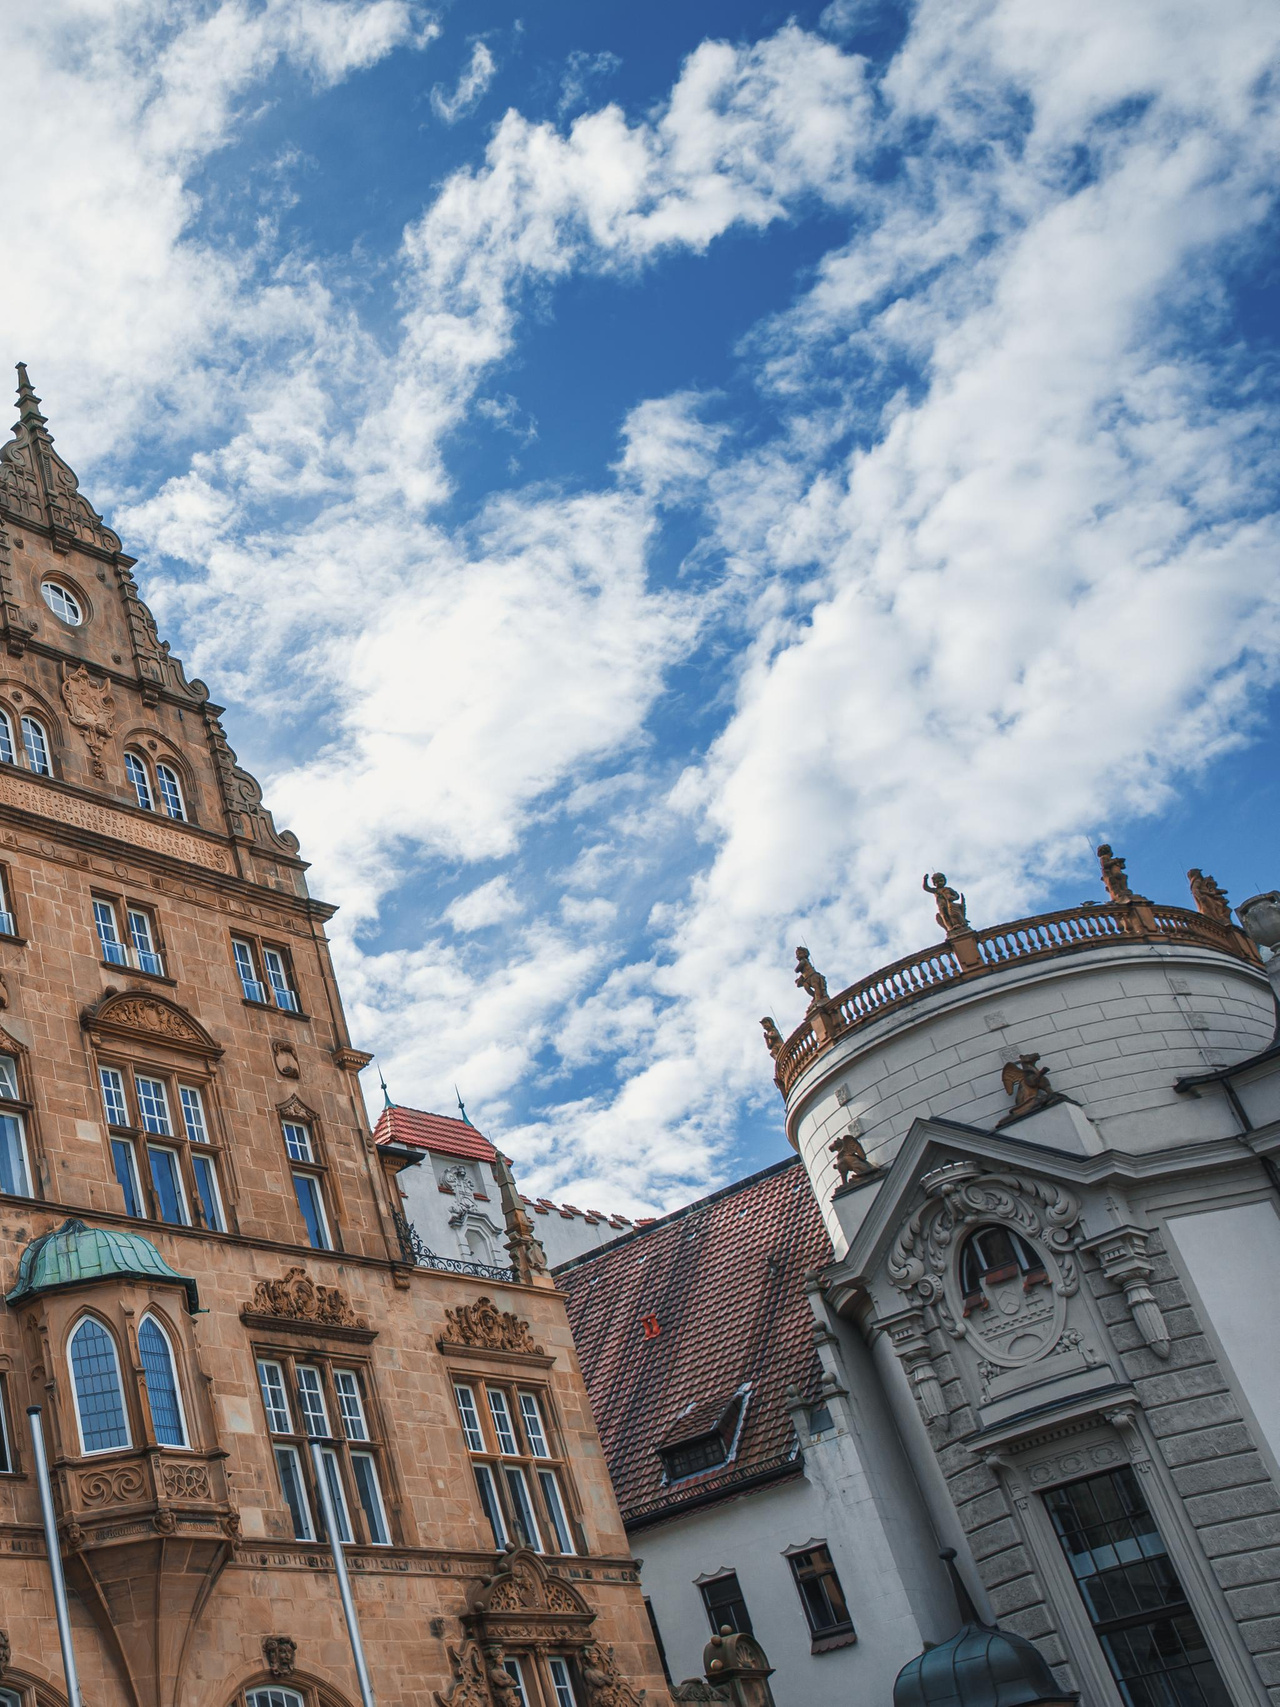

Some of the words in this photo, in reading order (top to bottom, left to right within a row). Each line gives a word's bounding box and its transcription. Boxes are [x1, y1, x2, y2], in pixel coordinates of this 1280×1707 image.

[23, 783, 52, 799] HAUS
[58, 795, 86, 810] STEH
[92, 806, 118, 820] FEST
[139, 822, 180, 841] GOTTES
[184, 836, 212, 851] HAND
[23, 791, 53, 808] TREU
[58, 803, 73, 814] ZU
[79, 810, 119, 829] KAISER
[125, 825, 148, 838] UND
[151, 833, 214, 859] VATERLAND
[74, 816, 106, 833] BIETE
[111, 828, 123, 838] ES
[128, 834, 168, 853] SCHUTZ
[171, 847, 192, 860] UND
